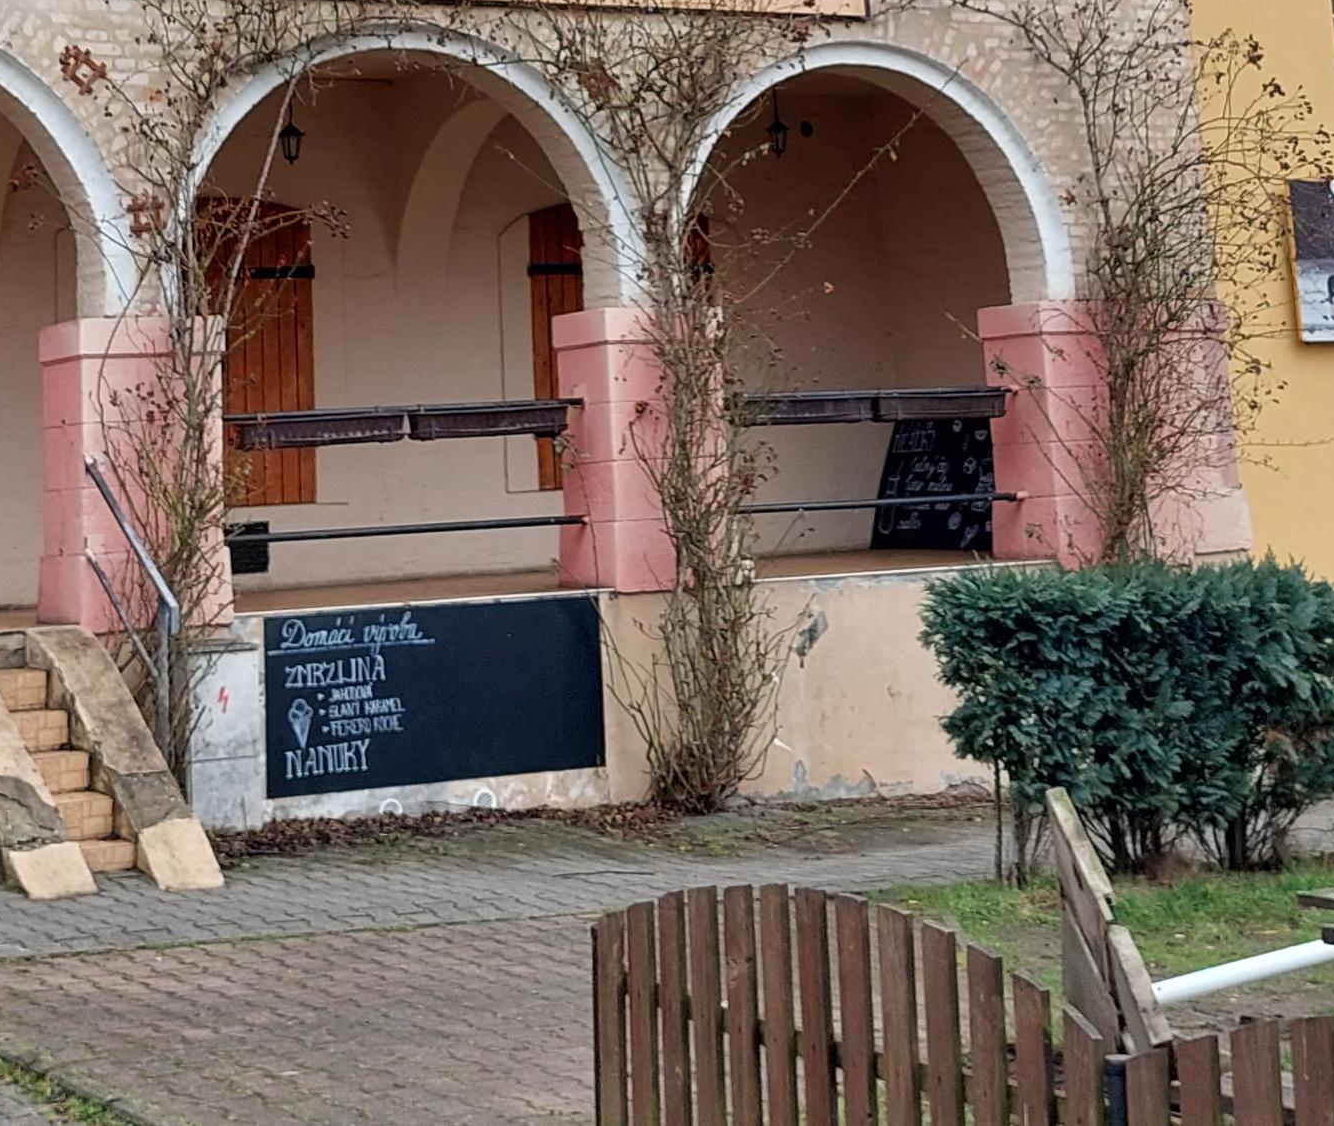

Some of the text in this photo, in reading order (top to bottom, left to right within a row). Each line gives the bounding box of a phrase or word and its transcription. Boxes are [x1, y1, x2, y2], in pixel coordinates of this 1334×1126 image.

[280, 611, 423, 655] Domácí výroba
[284, 654, 386, 688] ZMRZLINA
[284, 738, 370, 779] NANUKY
